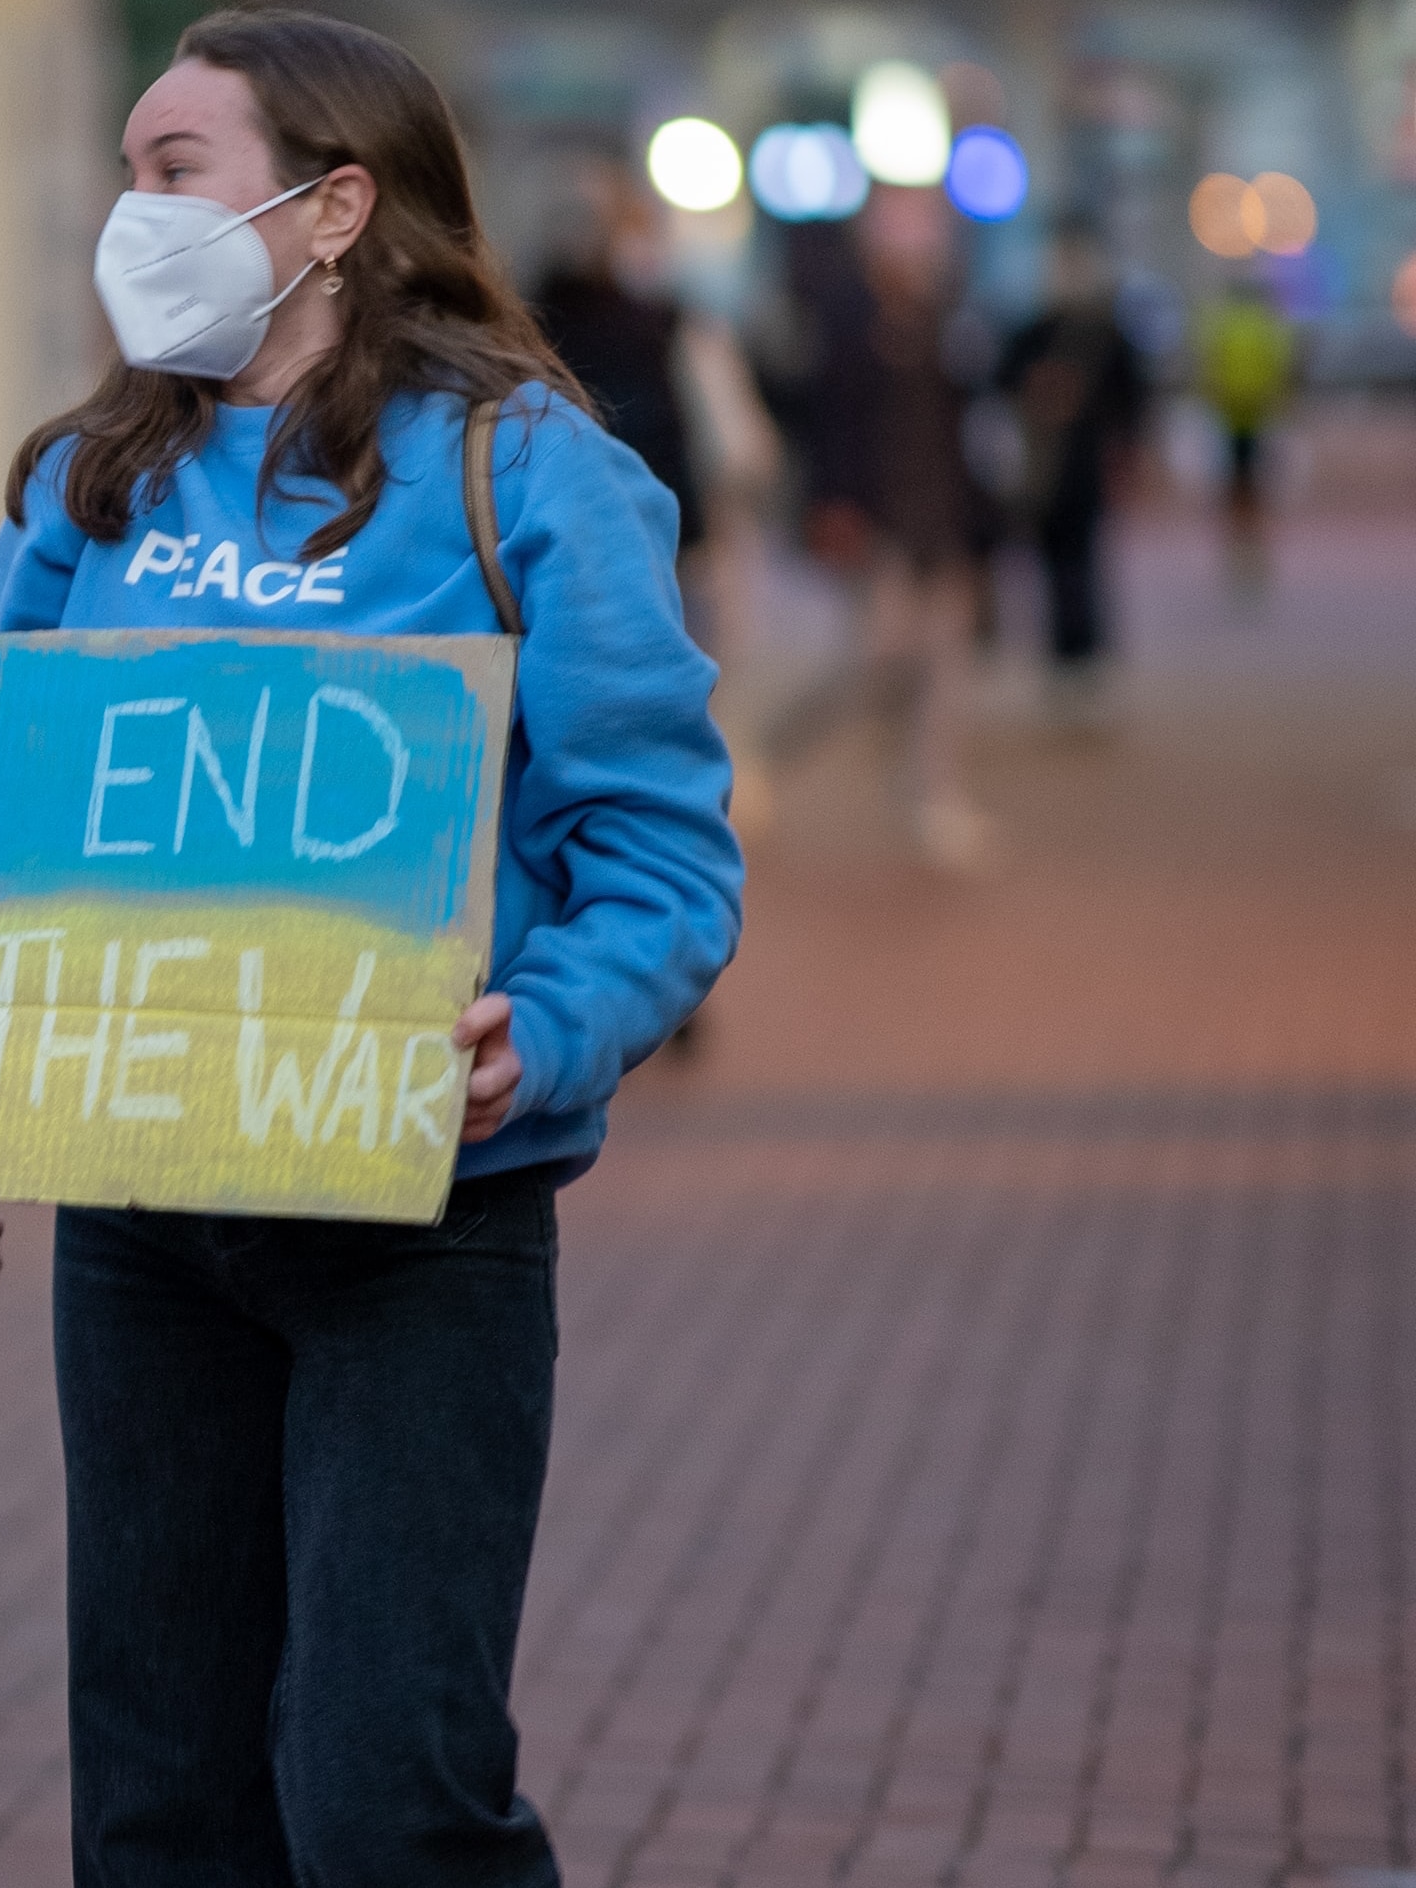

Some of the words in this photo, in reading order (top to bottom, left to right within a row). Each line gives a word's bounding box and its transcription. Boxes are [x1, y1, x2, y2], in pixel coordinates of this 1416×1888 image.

[124, 529, 349, 606] PEACE
[85, 685, 409, 863] END
[237, 949, 459, 1151] WAR
